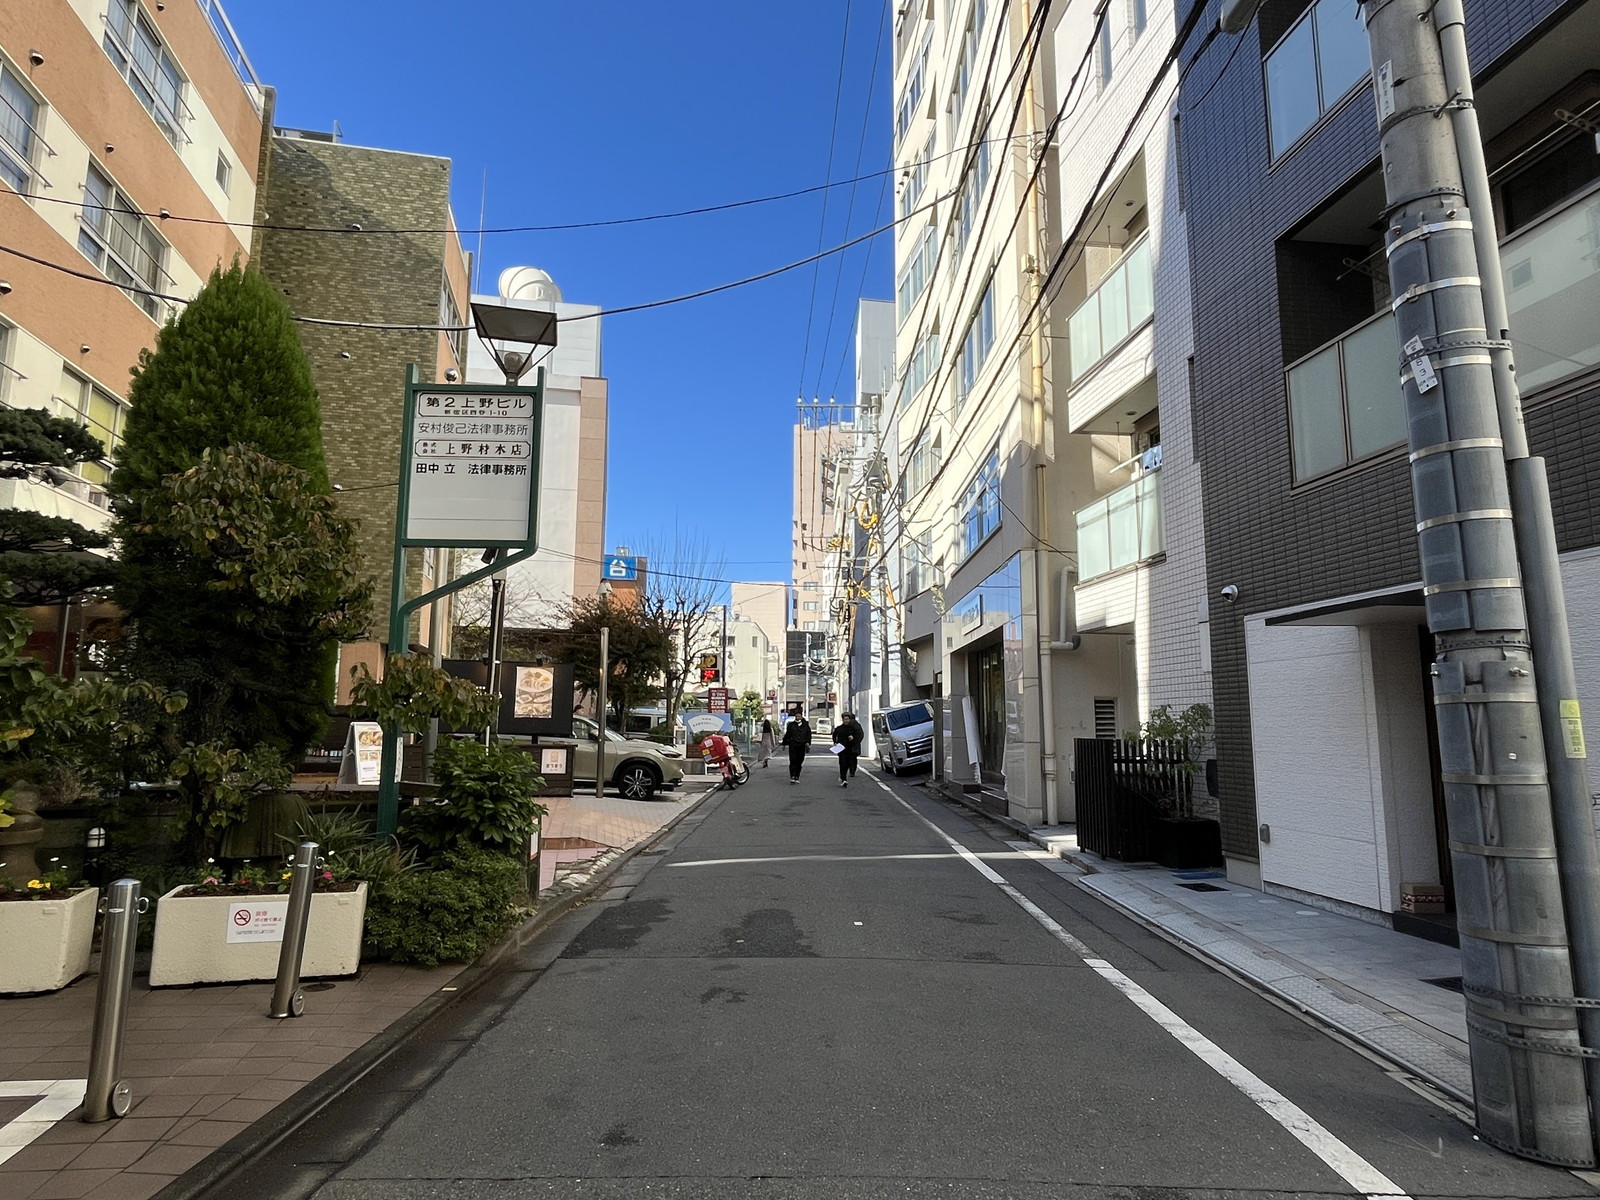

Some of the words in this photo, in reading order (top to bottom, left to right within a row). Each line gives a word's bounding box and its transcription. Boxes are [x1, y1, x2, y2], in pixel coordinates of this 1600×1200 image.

[445, 442, 523, 456] 上野材木店
[467, 463, 528, 476] 法律事務所
